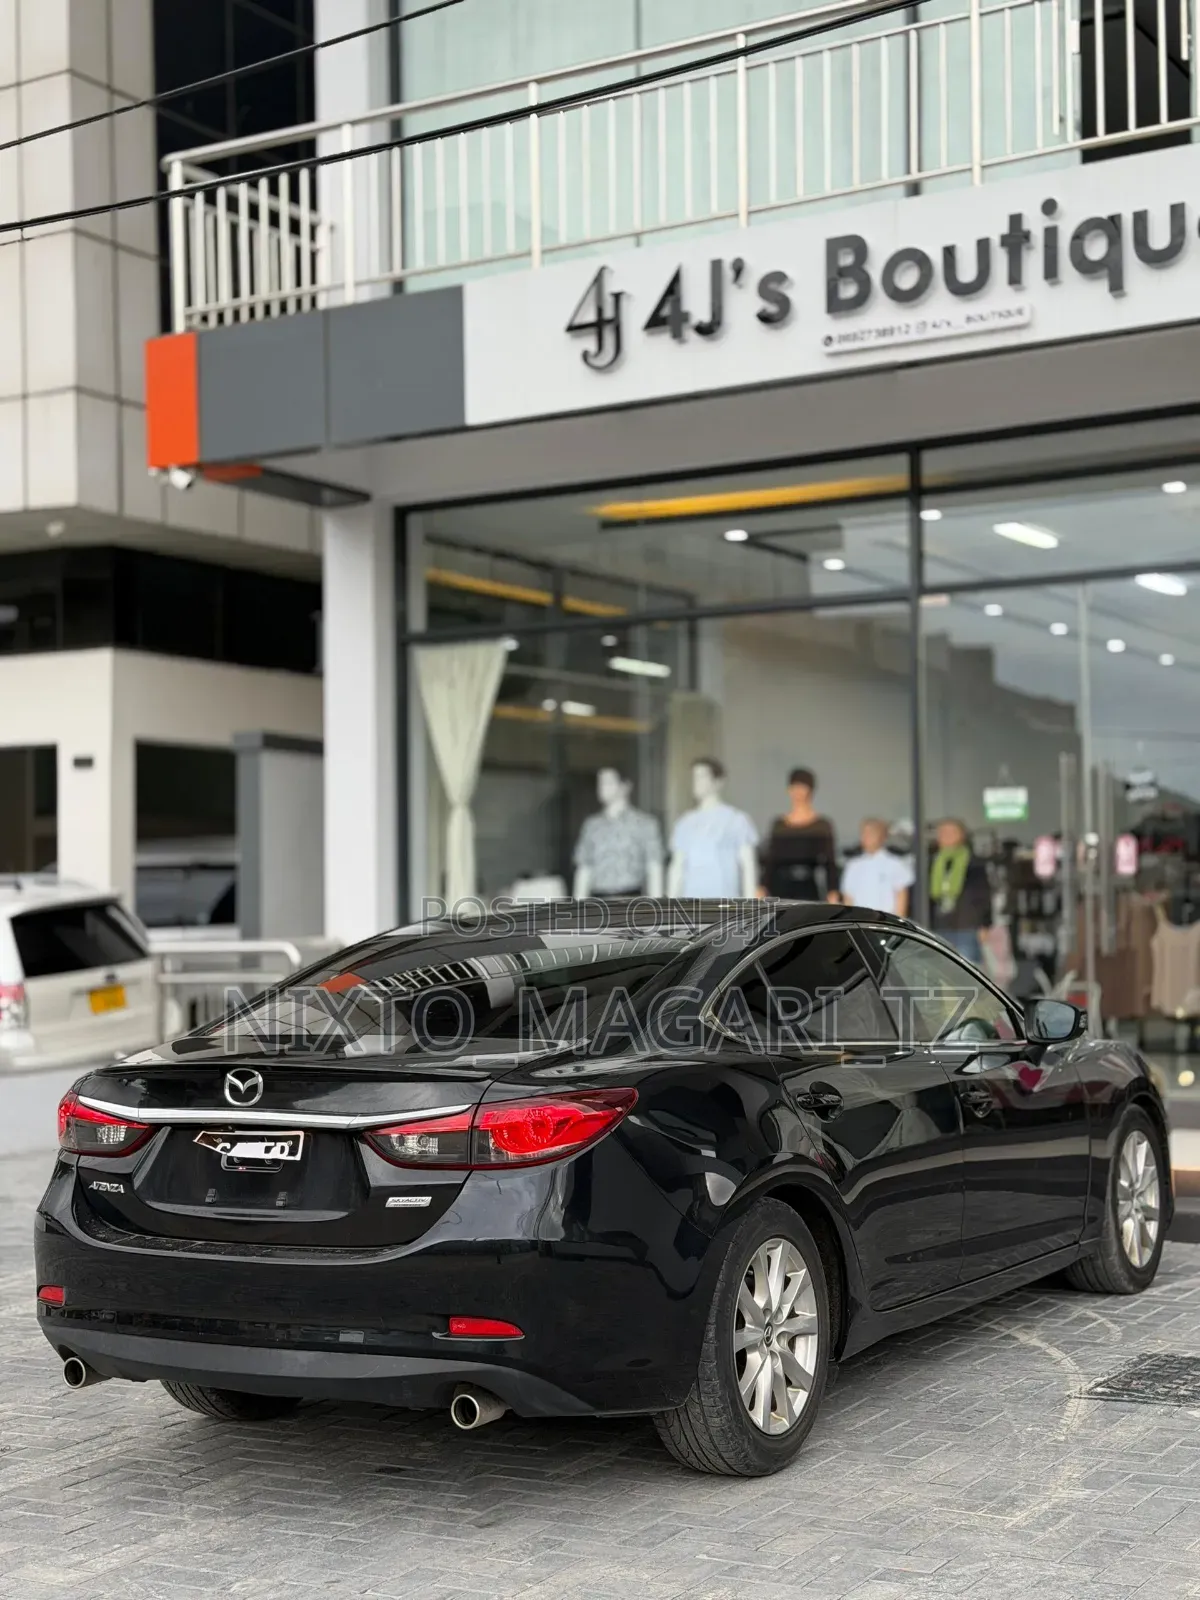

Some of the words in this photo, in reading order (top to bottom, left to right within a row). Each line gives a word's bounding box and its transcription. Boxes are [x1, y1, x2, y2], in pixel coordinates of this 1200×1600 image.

[643, 257, 792, 340] 4J's
[825, 197, 1200, 315] Boutiqu
[88, 1180, 125, 1194] ATENZA
